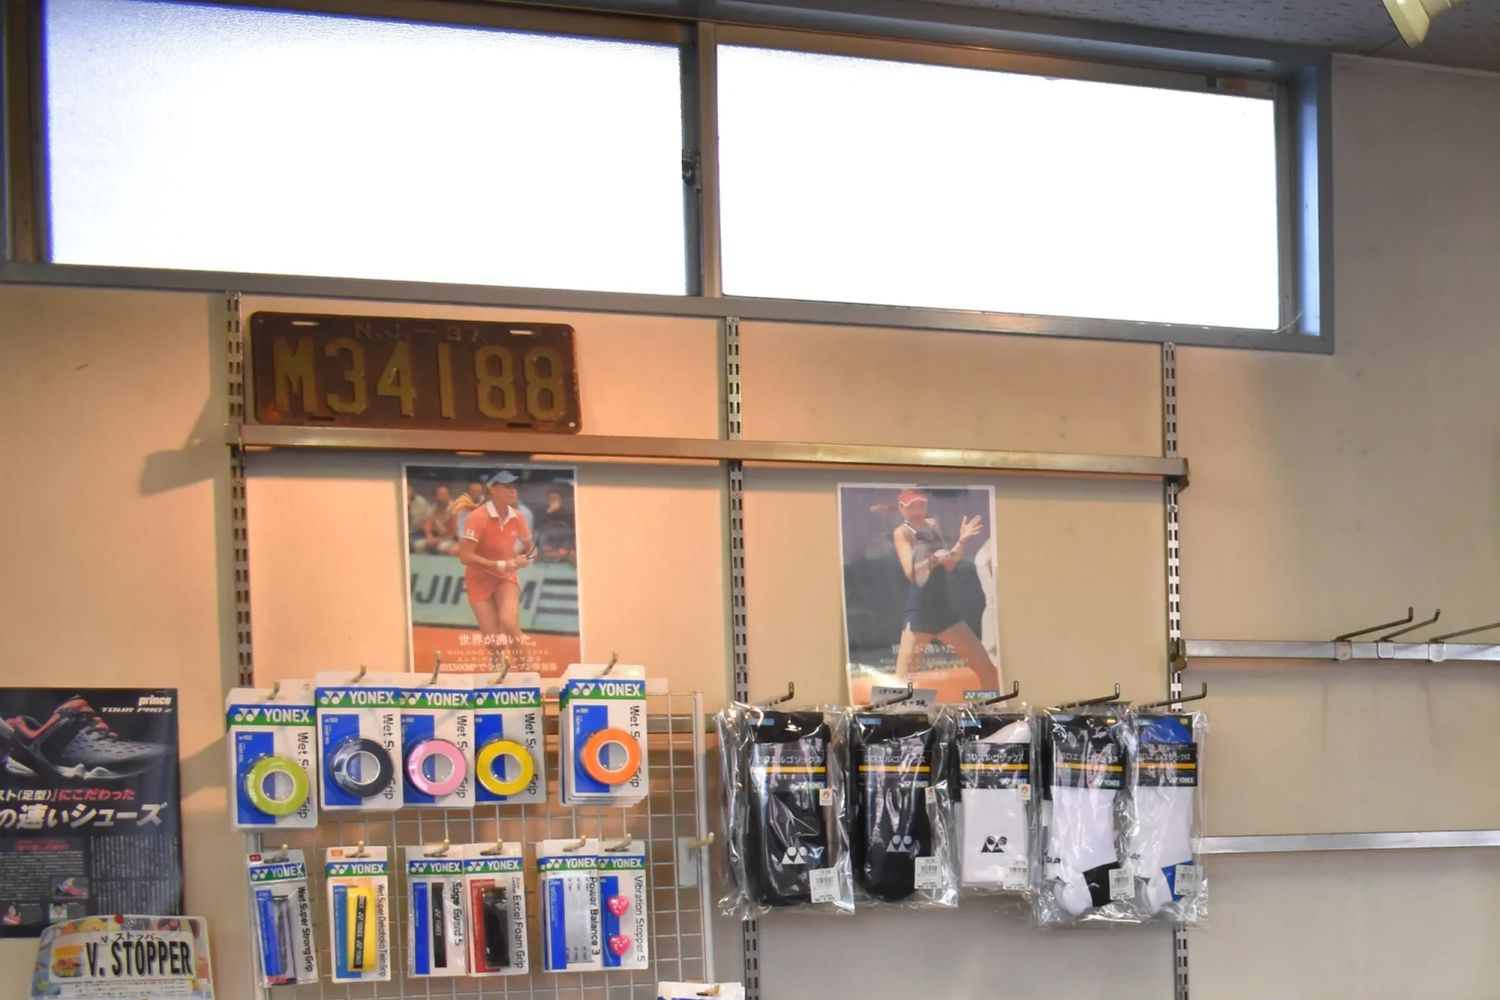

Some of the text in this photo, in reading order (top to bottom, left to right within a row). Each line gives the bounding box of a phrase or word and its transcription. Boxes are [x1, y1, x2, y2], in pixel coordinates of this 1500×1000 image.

[272, 334, 568, 422] M34188
[349, 691, 396, 704] YONEX
[425, 693, 469, 706] YONEX
[492, 691, 536, 705] YONEX
[598, 683, 641, 696] YONEX
[139, 696, 172, 706] prince
[264, 709, 310, 723] YONEX
[383, 714, 393, 736] Wet
[456, 715, 468, 738] Wet
[525, 714, 535, 736] Wet
[629, 705, 640, 729] Wet
[298, 732, 309, 755] Wet
[0, 802, 168, 829] の速いシューズ
[271, 864, 303, 878] YONEX
[352, 864, 384, 873] YONEX
[430, 862, 460, 873] YONEX
[487, 860, 520, 870] YONEX
[565, 858, 597, 868] YONEX
[612, 858, 642, 868] YONEX
[590, 876, 598, 905] Power
[634, 875, 643, 916] Vibration
[300, 902, 309, 926] Super
[377, 896, 385, 916] Super
[513, 894, 526, 969] Excel Foam Grip
[590, 908, 600, 948] Balance
[632, 918, 645, 954] Stopper
[303, 927, 312, 954] Strong
[85, 940, 193, 978] V. STOPPER
[304, 954, 313, 972] Grip
